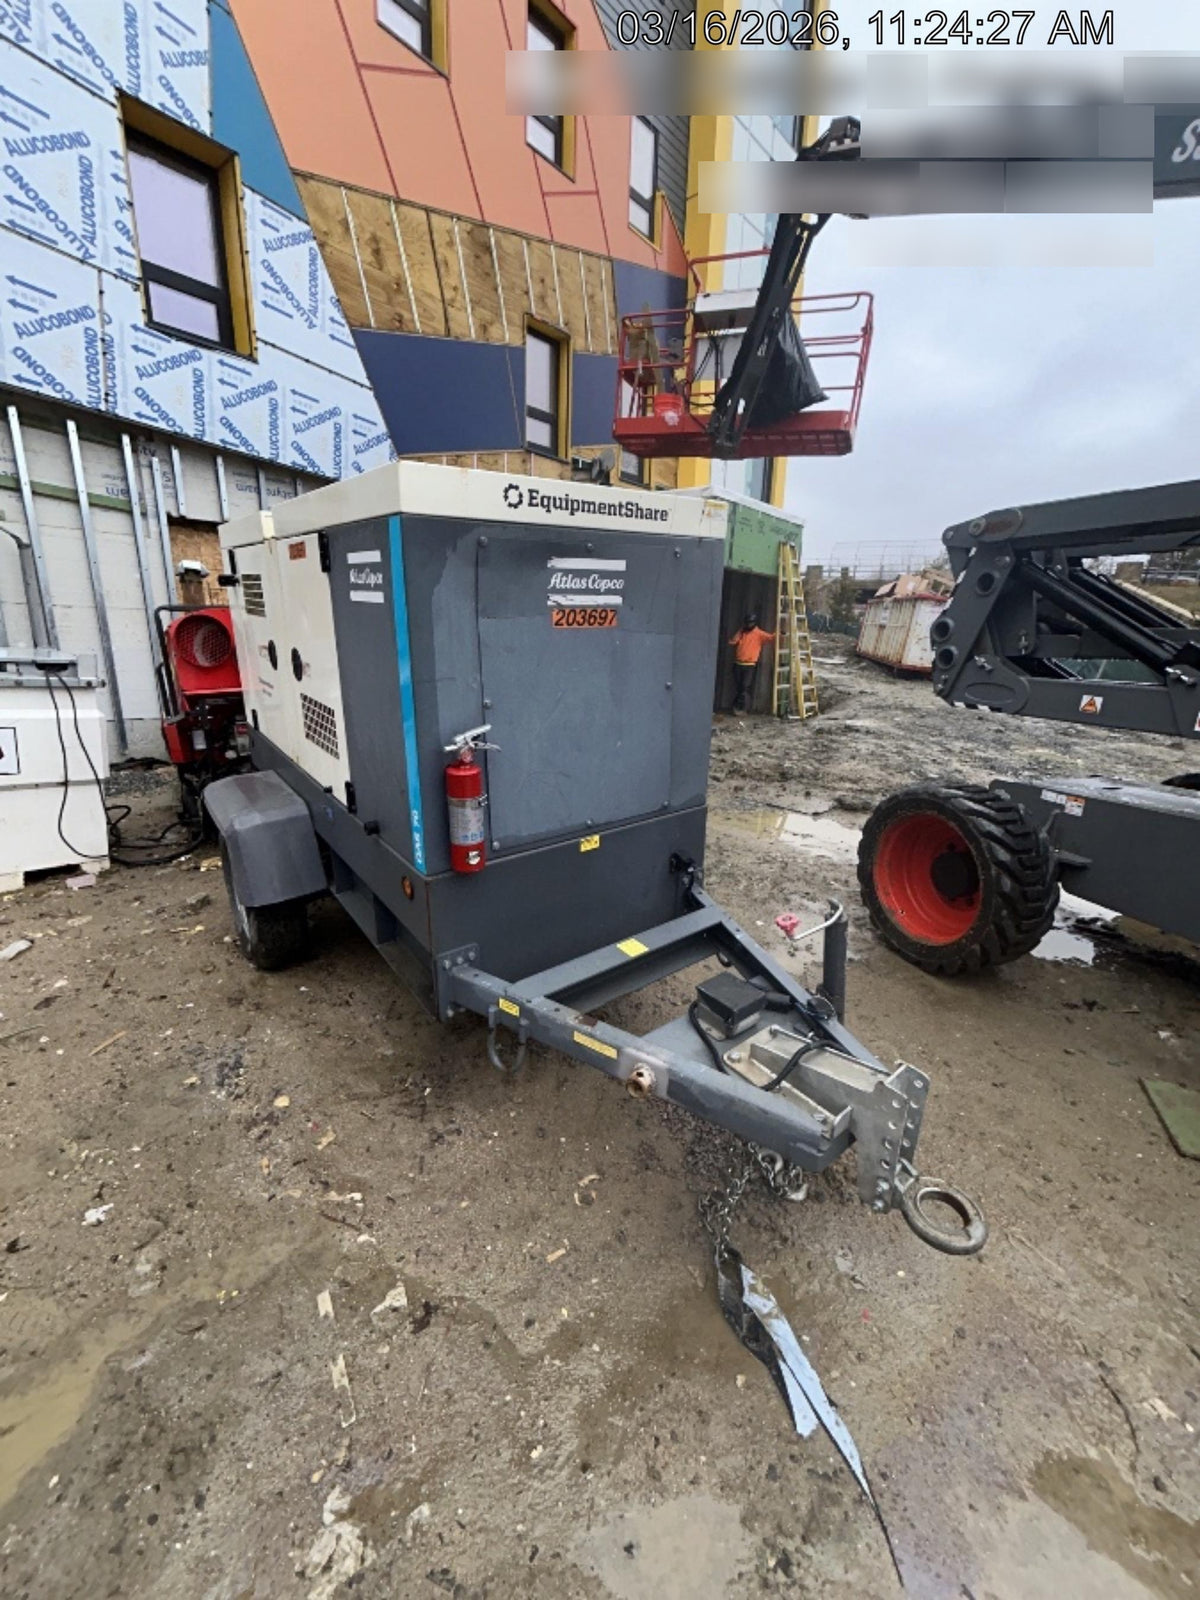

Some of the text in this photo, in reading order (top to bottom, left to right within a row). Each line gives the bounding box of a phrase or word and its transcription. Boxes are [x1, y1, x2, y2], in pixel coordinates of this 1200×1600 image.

[3, 131, 91, 157] ALUCOBOND
[3, 164, 96, 260] ALUCOBOND
[78, 154, 97, 247] ALUCOBOND
[260, 259, 318, 330] ALUCOBOND
[13, 304, 96, 339] ALUCOBOND
[135, 349, 203, 381] ALUCOBOND
[220, 379, 278, 410] ALUCOBOND
[528, 489, 669, 522] EquipmentShare
[547, 572, 625, 592] Atlas Copco
[553, 609, 617, 627] 203697
